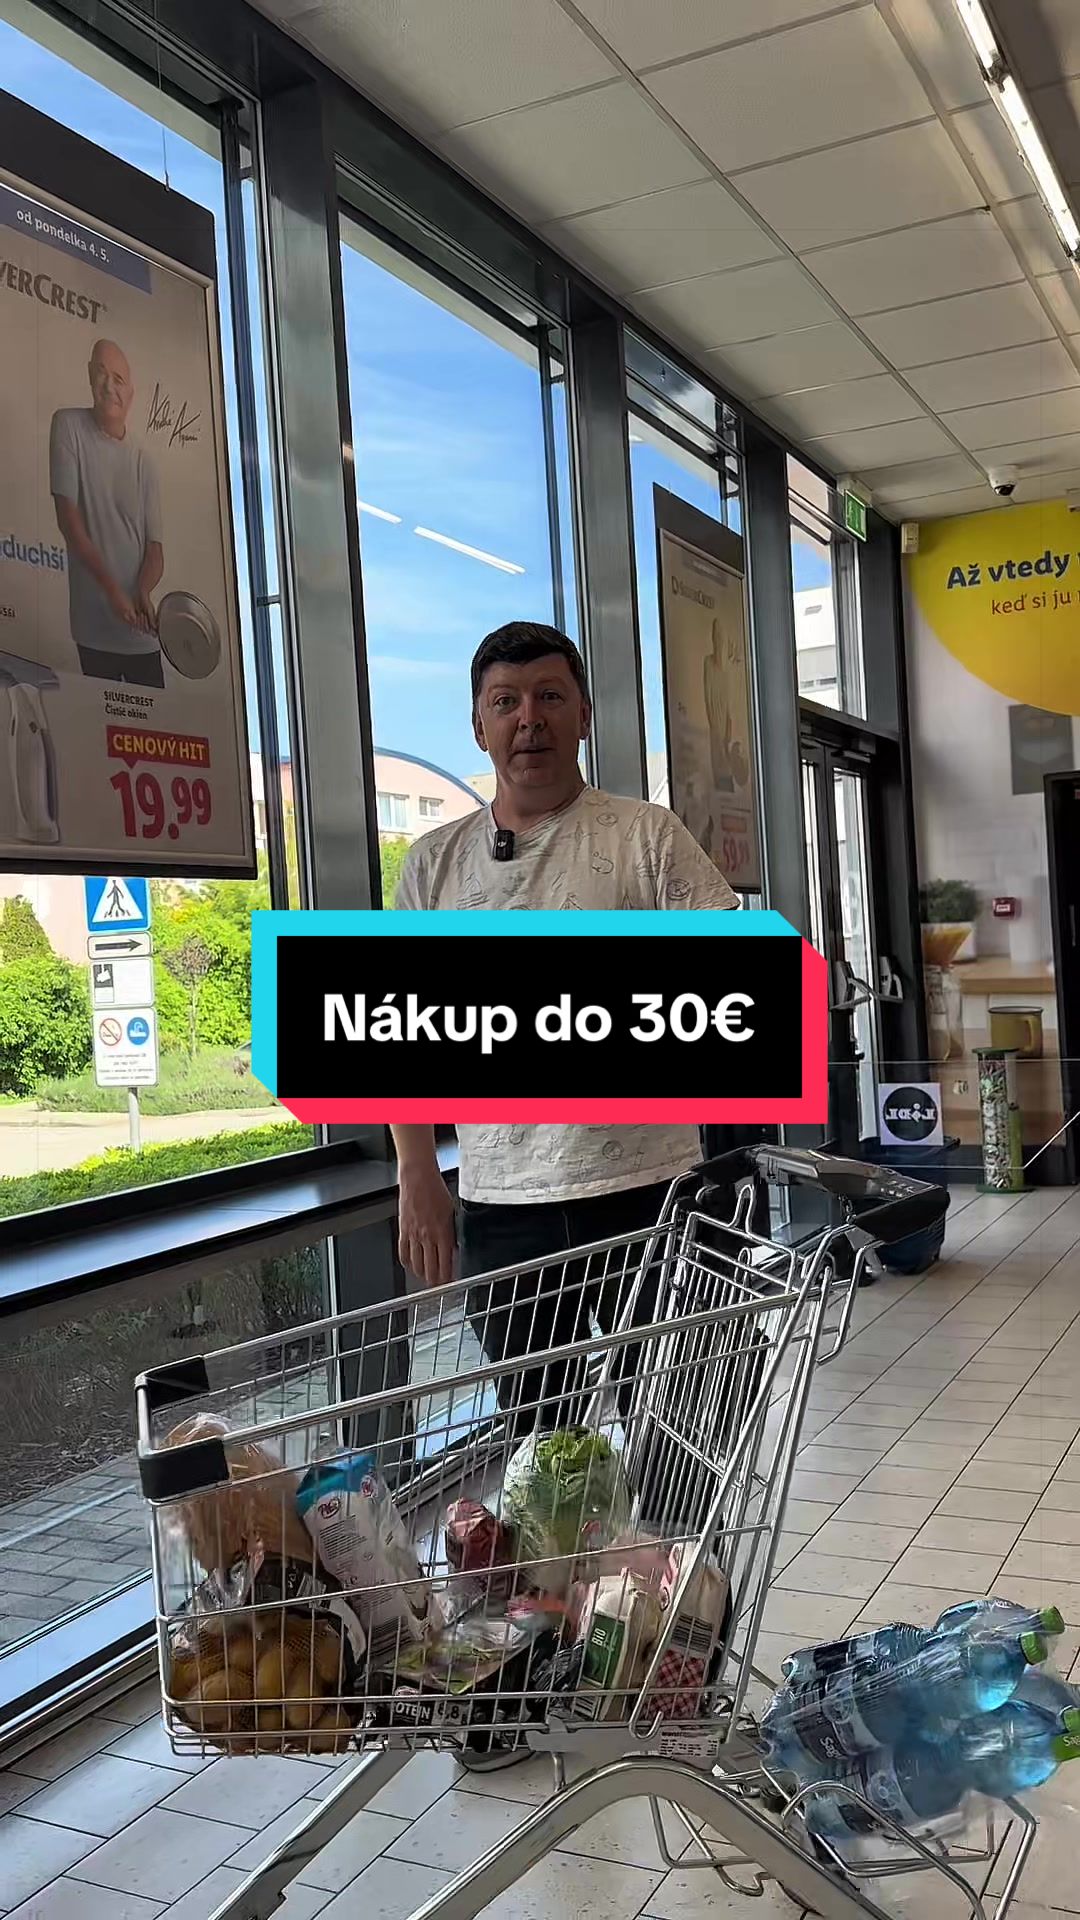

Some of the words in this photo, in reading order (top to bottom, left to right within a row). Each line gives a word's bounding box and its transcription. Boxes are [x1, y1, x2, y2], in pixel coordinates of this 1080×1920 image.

[16, 209, 33, 226] od
[34, 217, 88, 251] pondelka
[0, 534, 64, 571] duchší
[946, 562, 982, 590] Až
[988, 550, 1071, 580] vtedy
[991, 594, 1028, 615] keď
[1032, 591, 1046, 609] si
[1053, 589, 1072, 610] ju
[104, 690, 154, 707] SILVERCREST
[112, 733, 177, 757] CENOVÝ
[179, 741, 205, 761] HIT
[111, 770, 212, 840] 19.99
